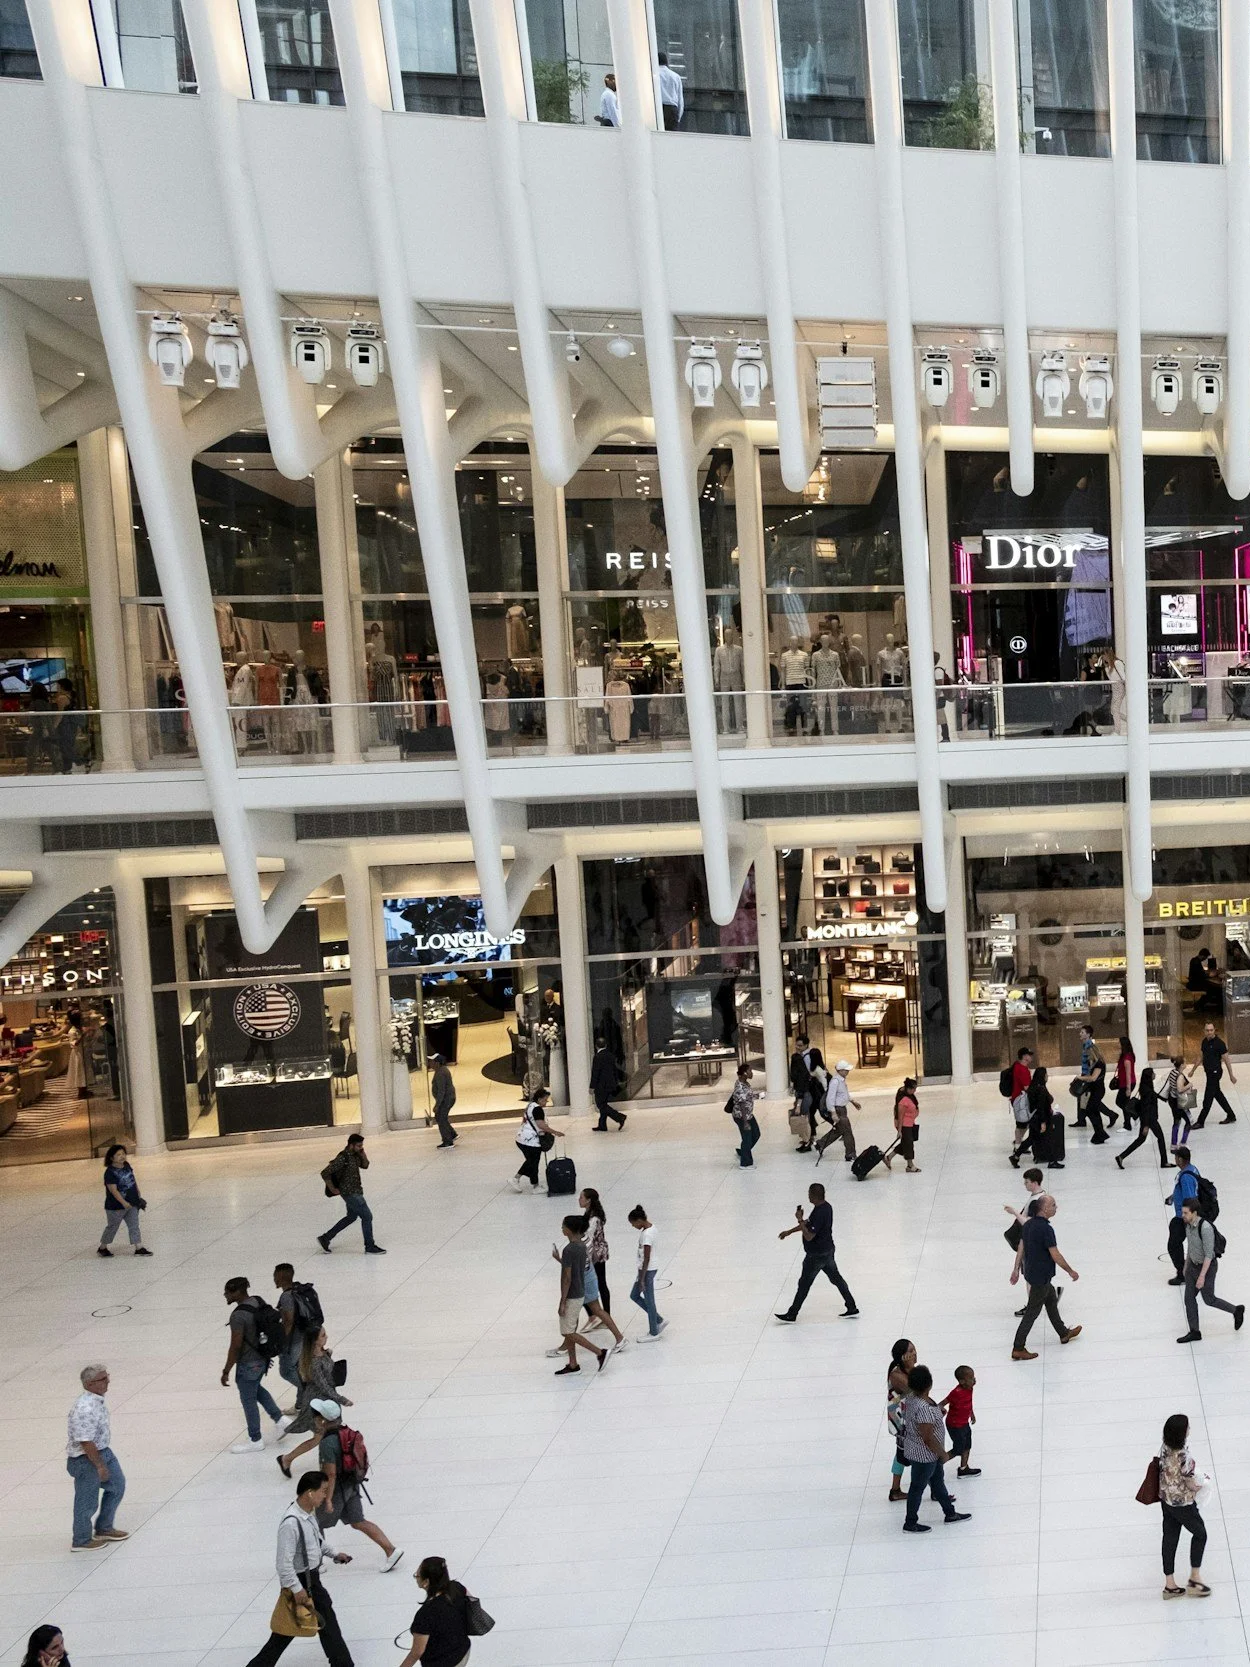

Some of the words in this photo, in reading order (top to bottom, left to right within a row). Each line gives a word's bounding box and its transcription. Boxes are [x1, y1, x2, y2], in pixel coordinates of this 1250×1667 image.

[606, 552, 671, 570] REI
[985, 535, 1083, 569] Dior
[803, 665, 905, 688] SALE
[807, 921, 907, 940] MONTBLANC
[0, 969, 103, 987] THSON
[236, 995, 255, 1034] EDITION
[265, 992, 299, 1038] EXCLUSIVE
